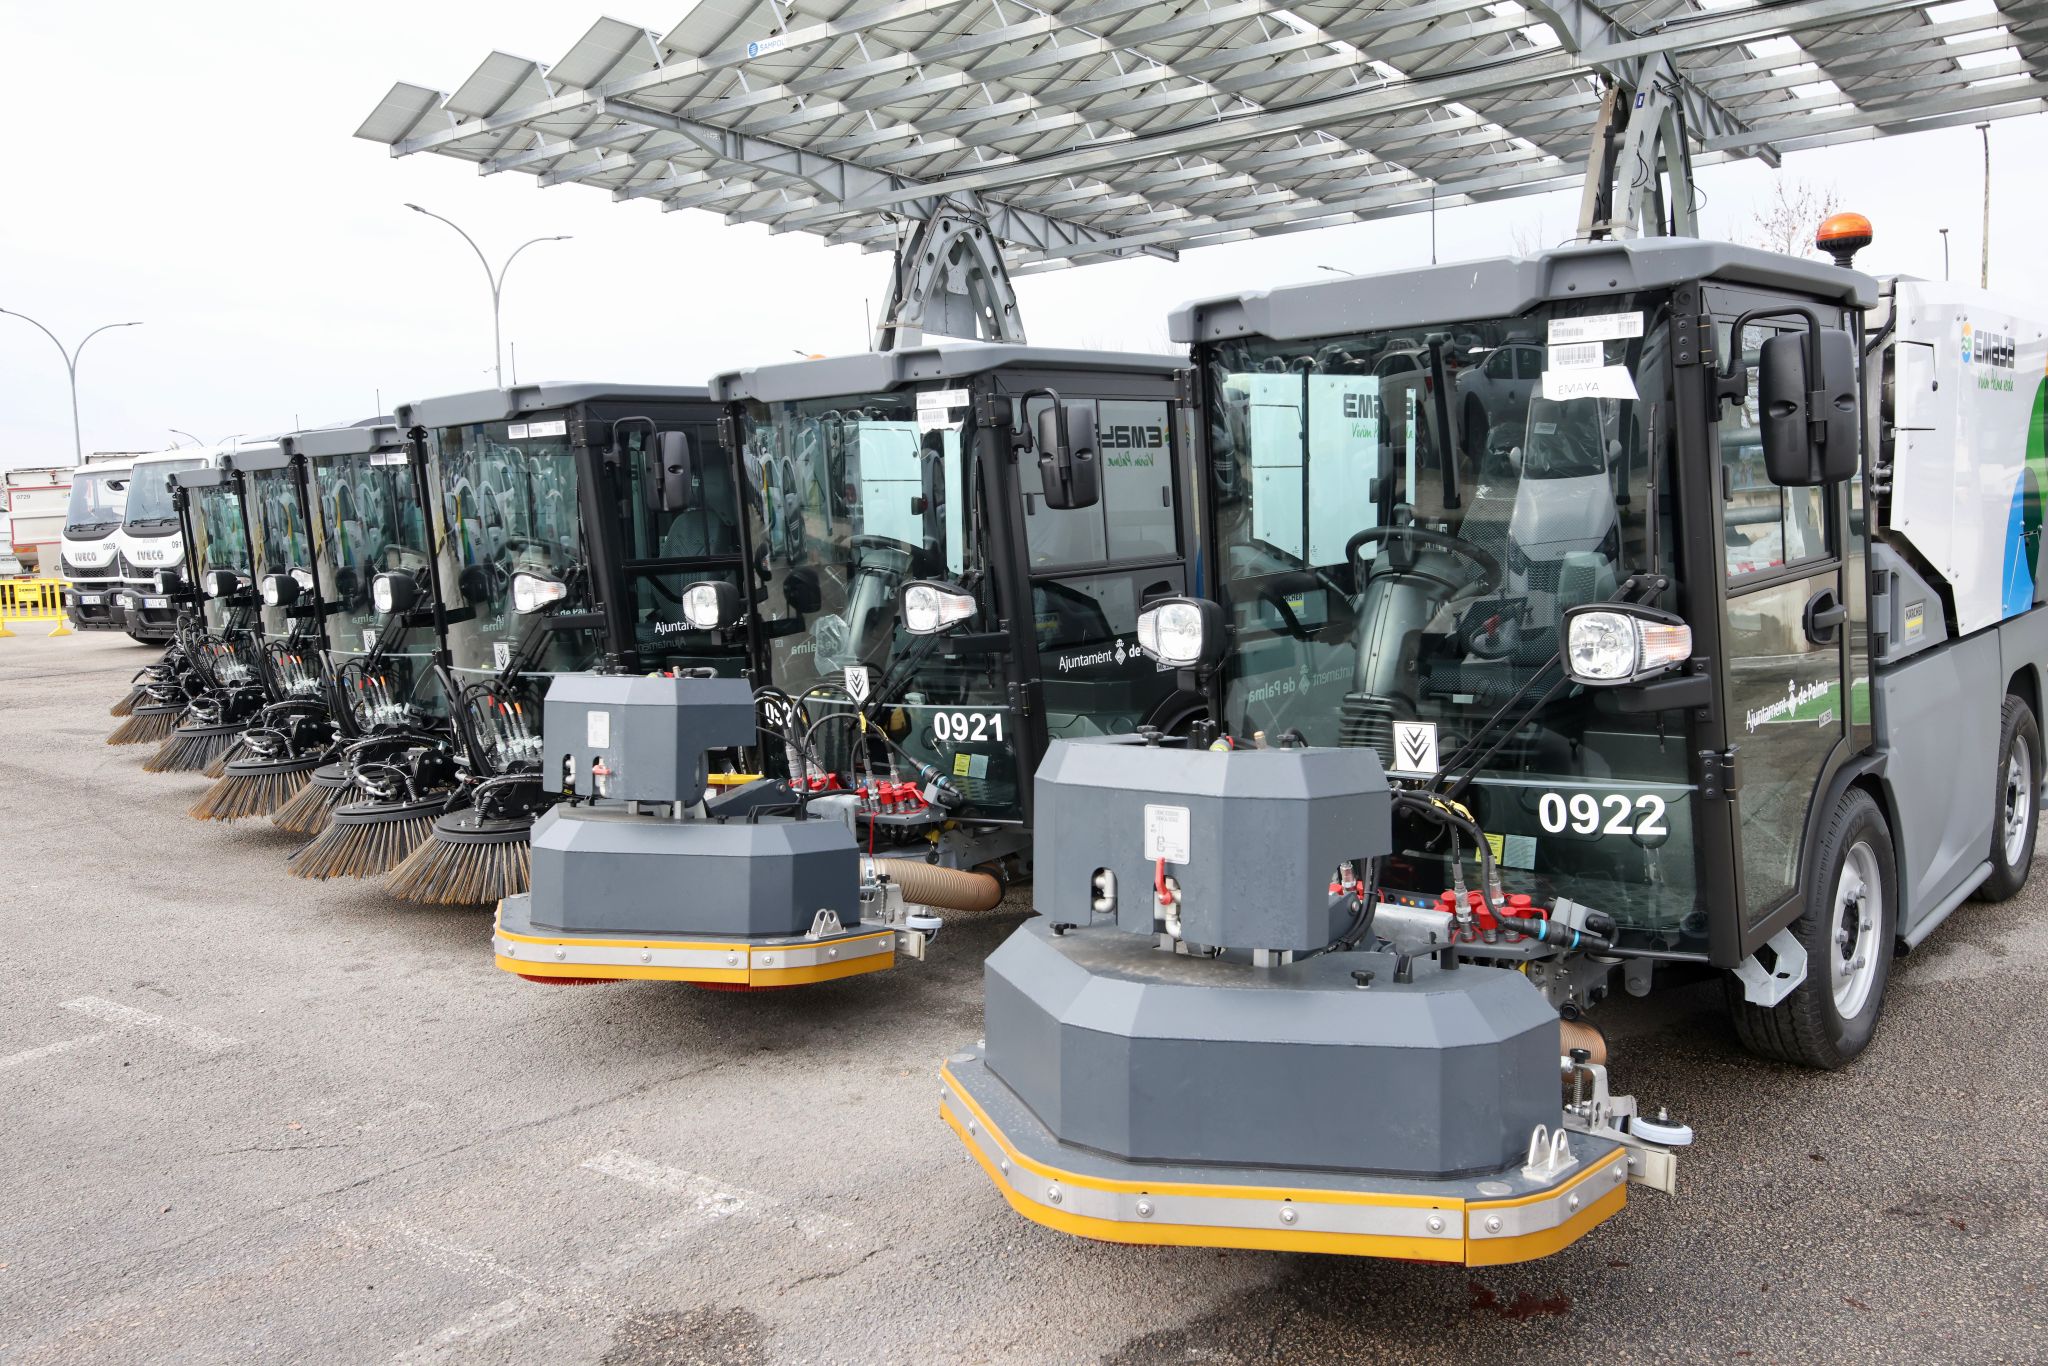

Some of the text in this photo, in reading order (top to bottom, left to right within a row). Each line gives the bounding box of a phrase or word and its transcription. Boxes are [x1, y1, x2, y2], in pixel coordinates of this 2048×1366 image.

[1558, 382, 1600, 395] EMAYA
[74, 551, 97, 561] IVECO
[137, 549, 164, 561] IVECO
[1058, 644, 1141, 673] Ajuntament de
[1745, 696, 1787, 733] Ajuntament
[1808, 680, 1828, 701] Palma
[933, 711, 1003, 742] 0921
[1538, 792, 1667, 836] 0922
